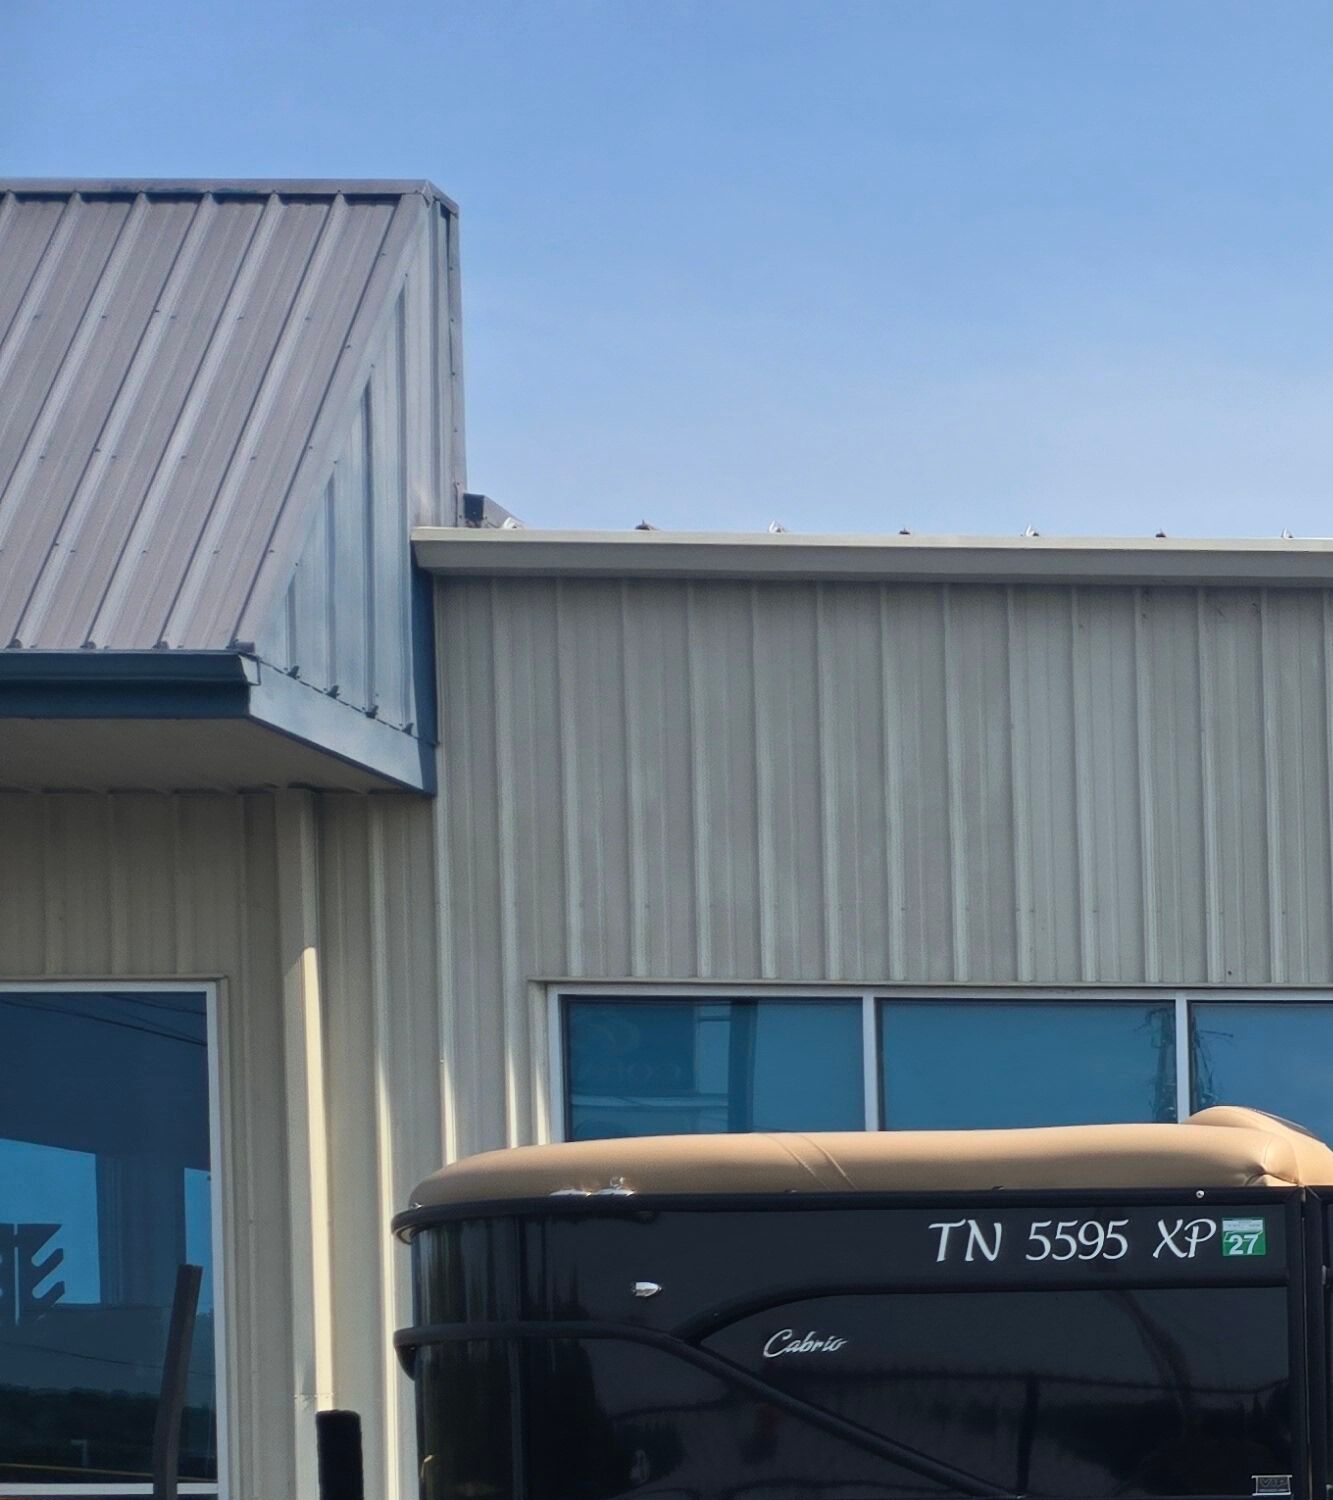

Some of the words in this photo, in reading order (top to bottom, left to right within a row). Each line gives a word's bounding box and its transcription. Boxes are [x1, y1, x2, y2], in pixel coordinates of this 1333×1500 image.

[928, 1218, 1002, 1262] TN
[1025, 1218, 1130, 1262] 5595
[1152, 1218, 1217, 1259] XP
[1229, 1234, 1259, 1255] 27
[763, 1328, 848, 1358] Cabrio
